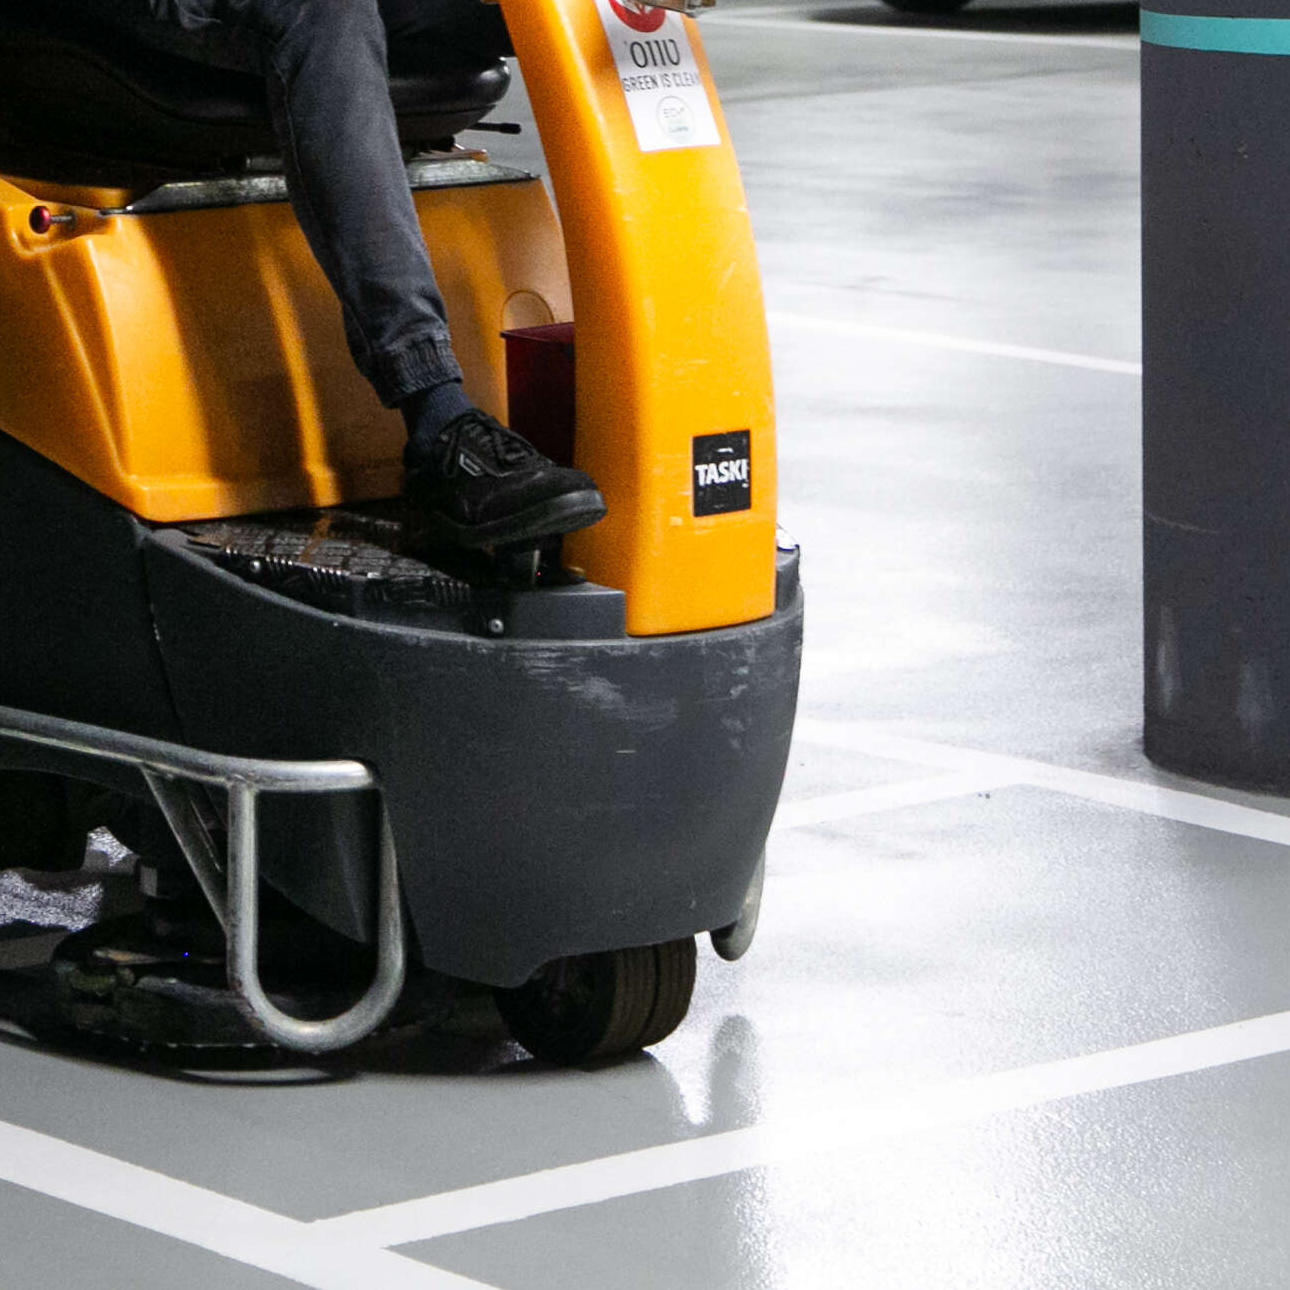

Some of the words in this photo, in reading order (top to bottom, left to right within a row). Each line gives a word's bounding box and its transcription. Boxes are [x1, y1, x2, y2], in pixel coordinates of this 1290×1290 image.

[622, 74, 659, 93] GREEN
[660, 72, 672, 89] IS
[694, 458, 748, 487] TASKI
